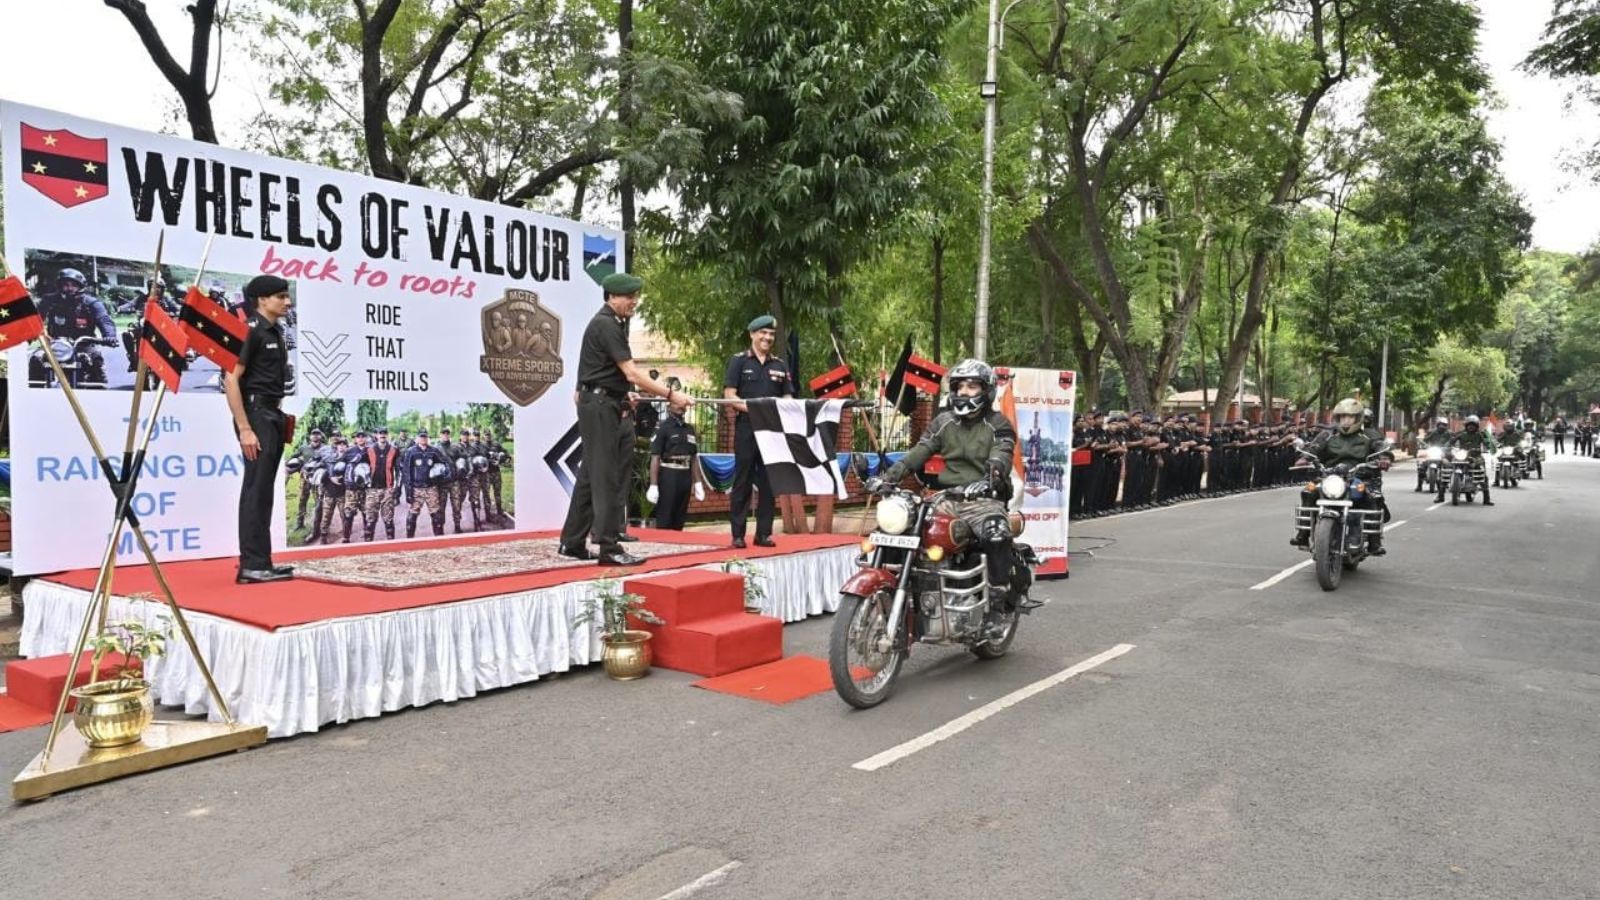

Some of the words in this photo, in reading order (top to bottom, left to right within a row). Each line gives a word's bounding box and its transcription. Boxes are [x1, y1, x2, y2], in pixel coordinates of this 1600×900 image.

[121, 147, 343, 253] WHEELS
[360, 192, 410, 260] OF
[424, 205, 570, 282] VALOUR
[259, 245, 342, 283] back
[354, 261, 389, 288] to
[400, 273, 478, 299] roots
[509, 290, 537, 303] MCTE
[366, 303, 402, 327] RIDE
[366, 335, 406, 359] THAT
[482, 357, 523, 371] XTREME
[524, 359, 562, 374] SPORTS
[366, 369, 429, 392] THRILLS
[37, 455, 186, 482] RAISNG
[132, 491, 177, 517] OF
